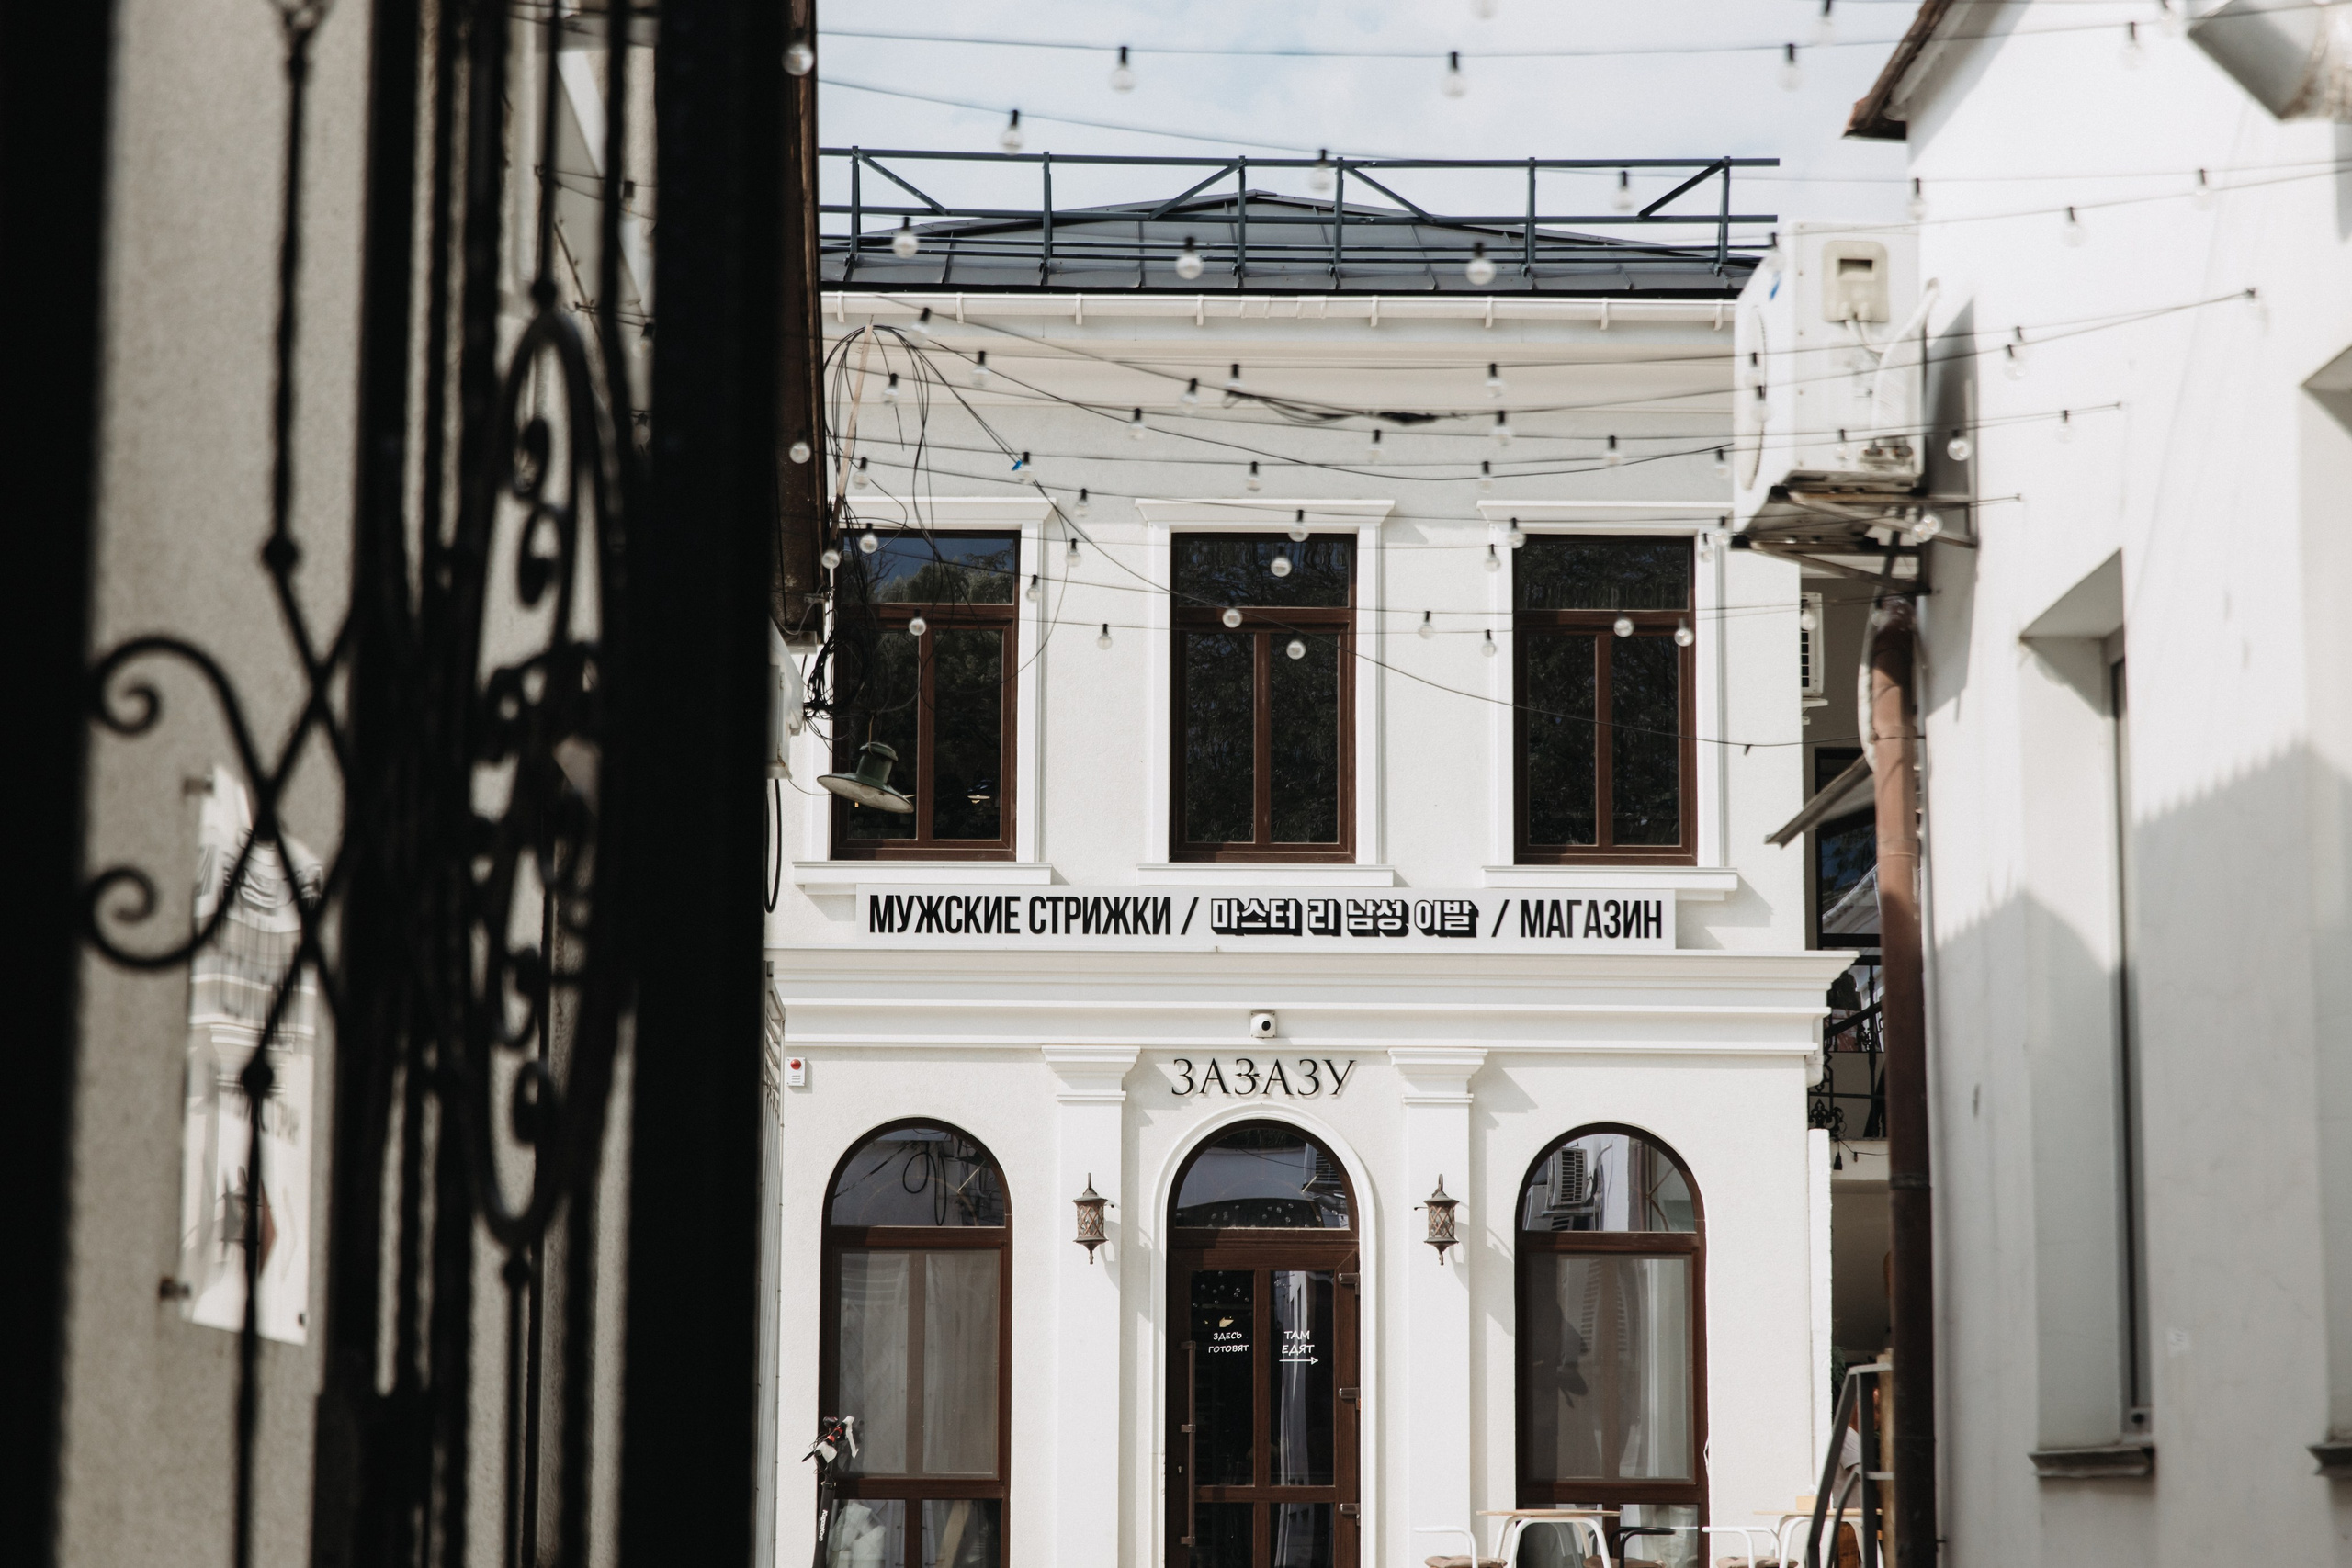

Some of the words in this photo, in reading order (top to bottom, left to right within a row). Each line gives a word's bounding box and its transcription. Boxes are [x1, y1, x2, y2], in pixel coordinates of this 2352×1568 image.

[869, 894, 1021, 934] МУЖСКИЕ
[1028, 895, 1171, 935] СТРИЖКИ
[1210, 897, 1303, 937] 마스터
[1307, 898, 1342, 937] 리
[1346, 898, 1409, 938] 남성
[1414, 899, 1479, 939] 이발
[1521, 899, 1663, 939] МАГАЗИН
[1171, 1057, 1356, 1096] ЗАЗАЗУ
[1213, 1331, 1242, 1341] ЗДЕСЬ
[1283, 1330, 1310, 1340] ТАМ
[1208, 1344, 1250, 1354] ГОТОВЯТ
[1281, 1344, 1315, 1357] ЕДЯТ
